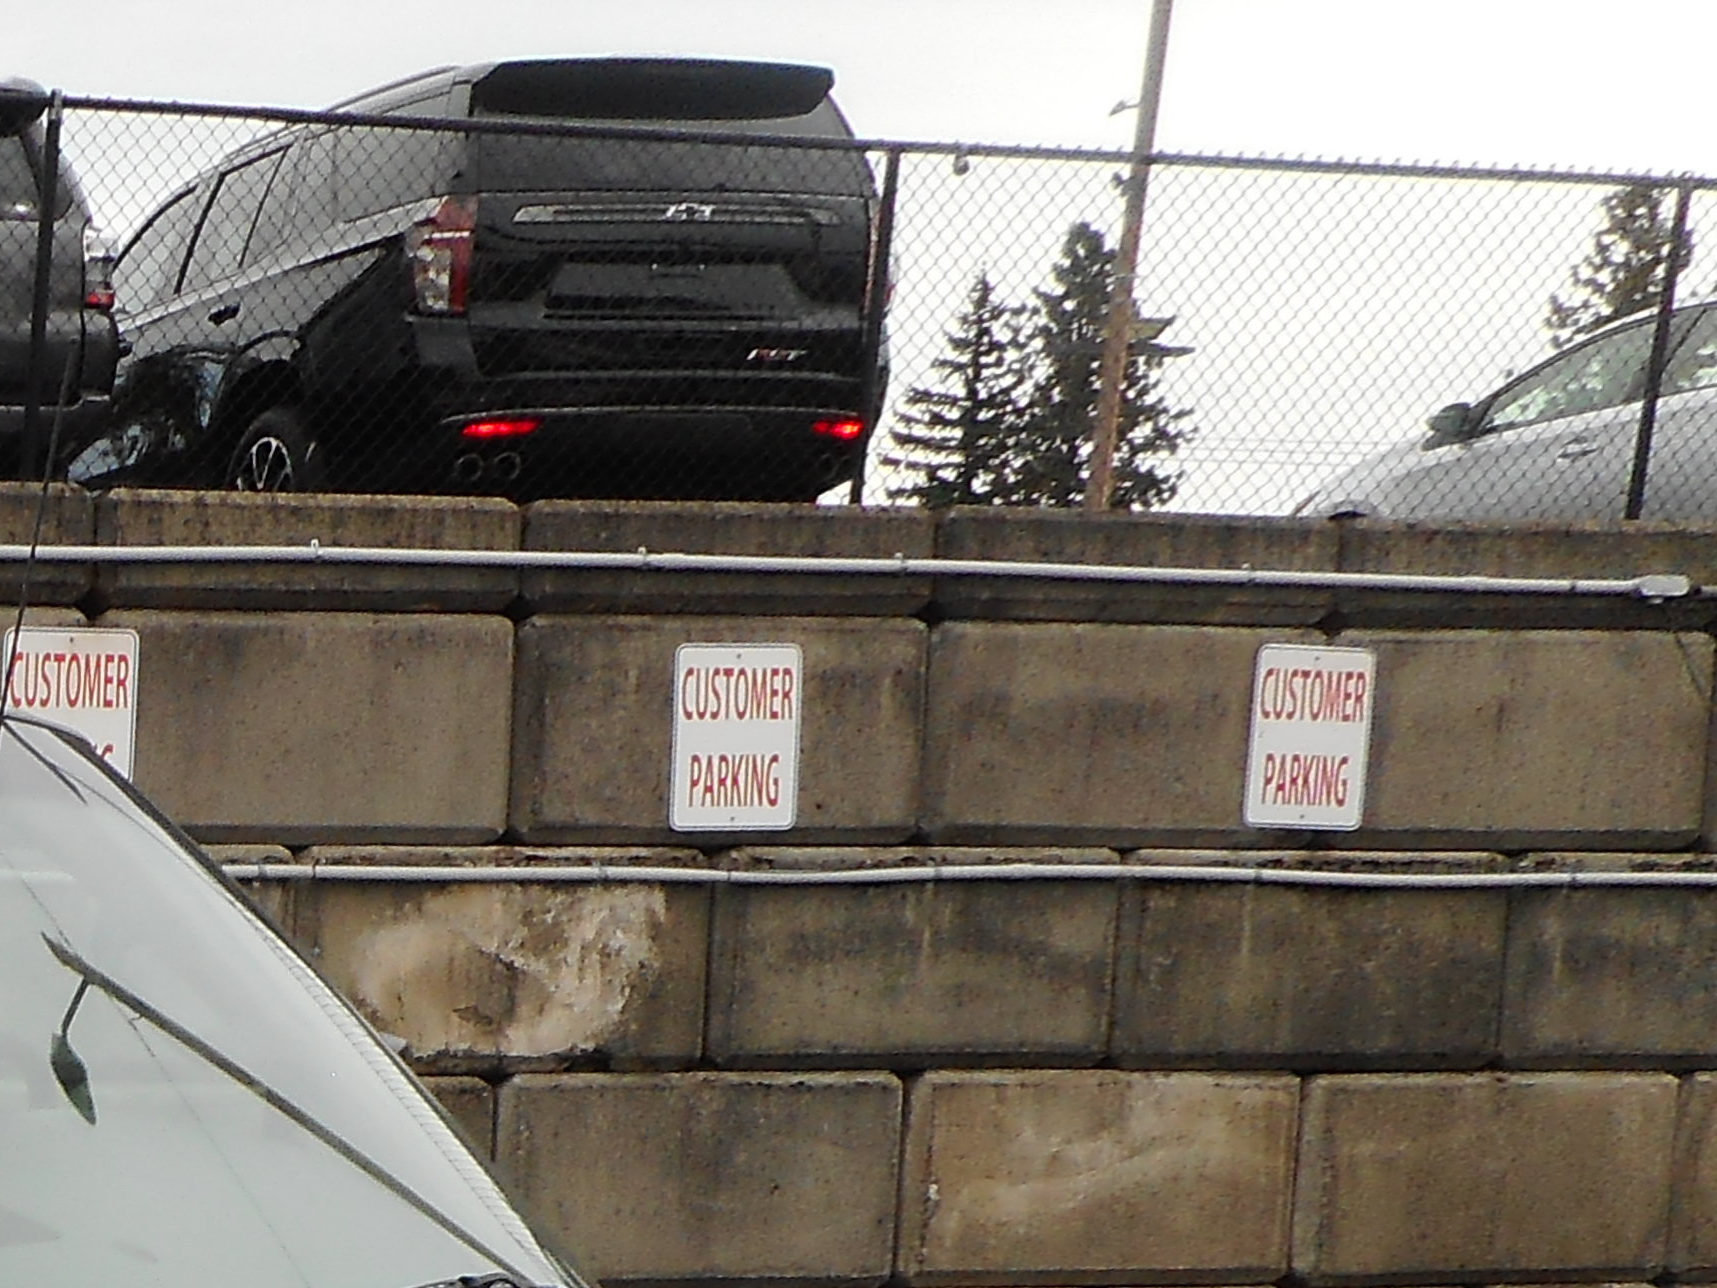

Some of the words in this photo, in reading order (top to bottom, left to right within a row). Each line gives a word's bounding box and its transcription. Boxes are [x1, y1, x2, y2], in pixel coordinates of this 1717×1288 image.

[8, 652, 130, 709] CUSTOMER
[681, 666, 794, 720] CUSTOMER
[1260, 667, 1367, 723] CUSTOMER
[688, 753, 780, 808] PARKING
[1261, 753, 1350, 808] PARKING
